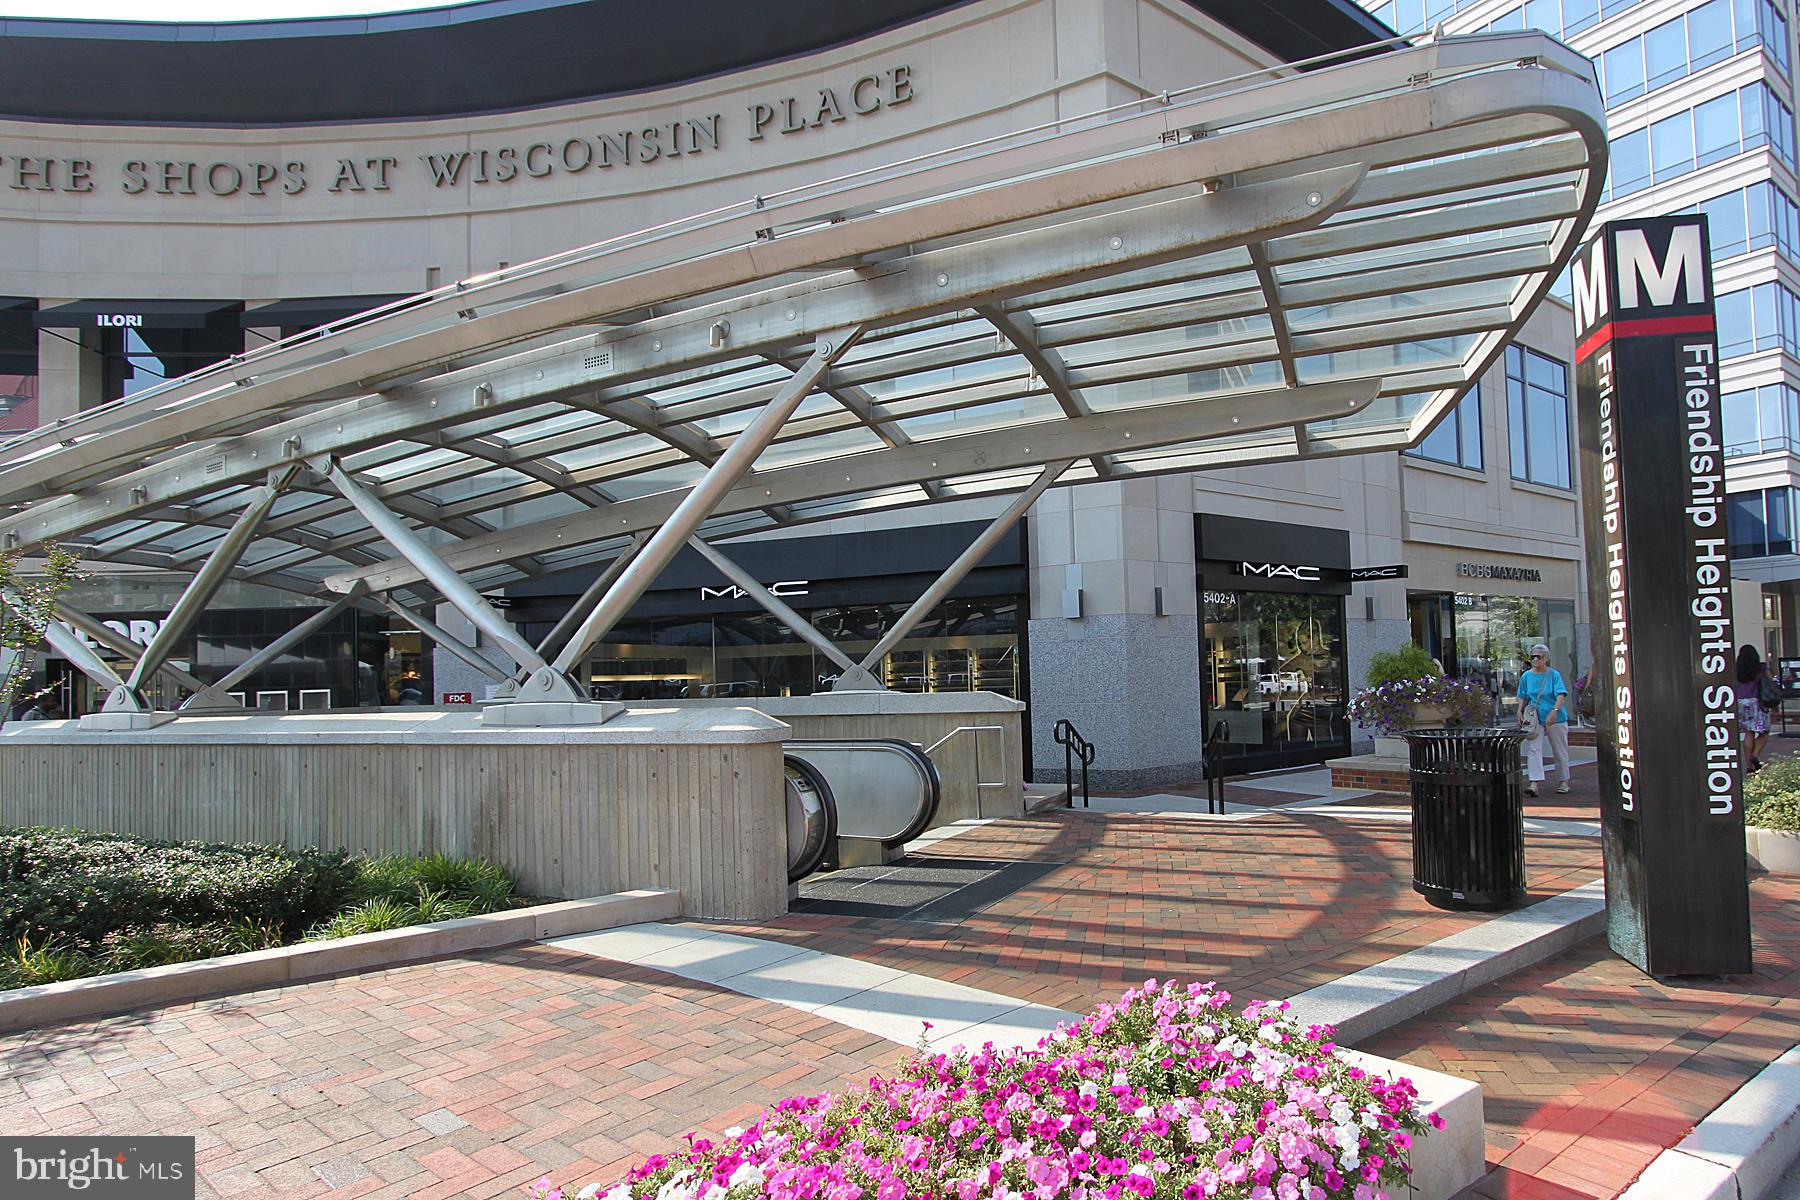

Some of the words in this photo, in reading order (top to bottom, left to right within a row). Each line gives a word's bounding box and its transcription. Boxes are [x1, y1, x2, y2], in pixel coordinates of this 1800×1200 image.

[0, 156, 93, 192] HE
[121, 160, 307, 195] SHOPS
[328, 156, 397, 192] AT
[420, 113, 721, 187] WISCONSIN
[747, 64, 914, 141] PLACE
[97, 314, 142, 327] ILORI
[1571, 235, 1608, 339] M
[1615, 224, 1705, 309] M
[1598, 350, 1620, 534] Friendship
[1683, 344, 1723, 527] Friendship
[1203, 592, 1236, 605] 5402-A
[1455, 595, 1468, 605] 5402
[1608, 542, 1628, 676] Heights
[1691, 538, 1732, 674] Heights
[449, 694, 466, 702] FDC
[1616, 686, 1635, 812] Station
[1703, 685, 1738, 815] Station
